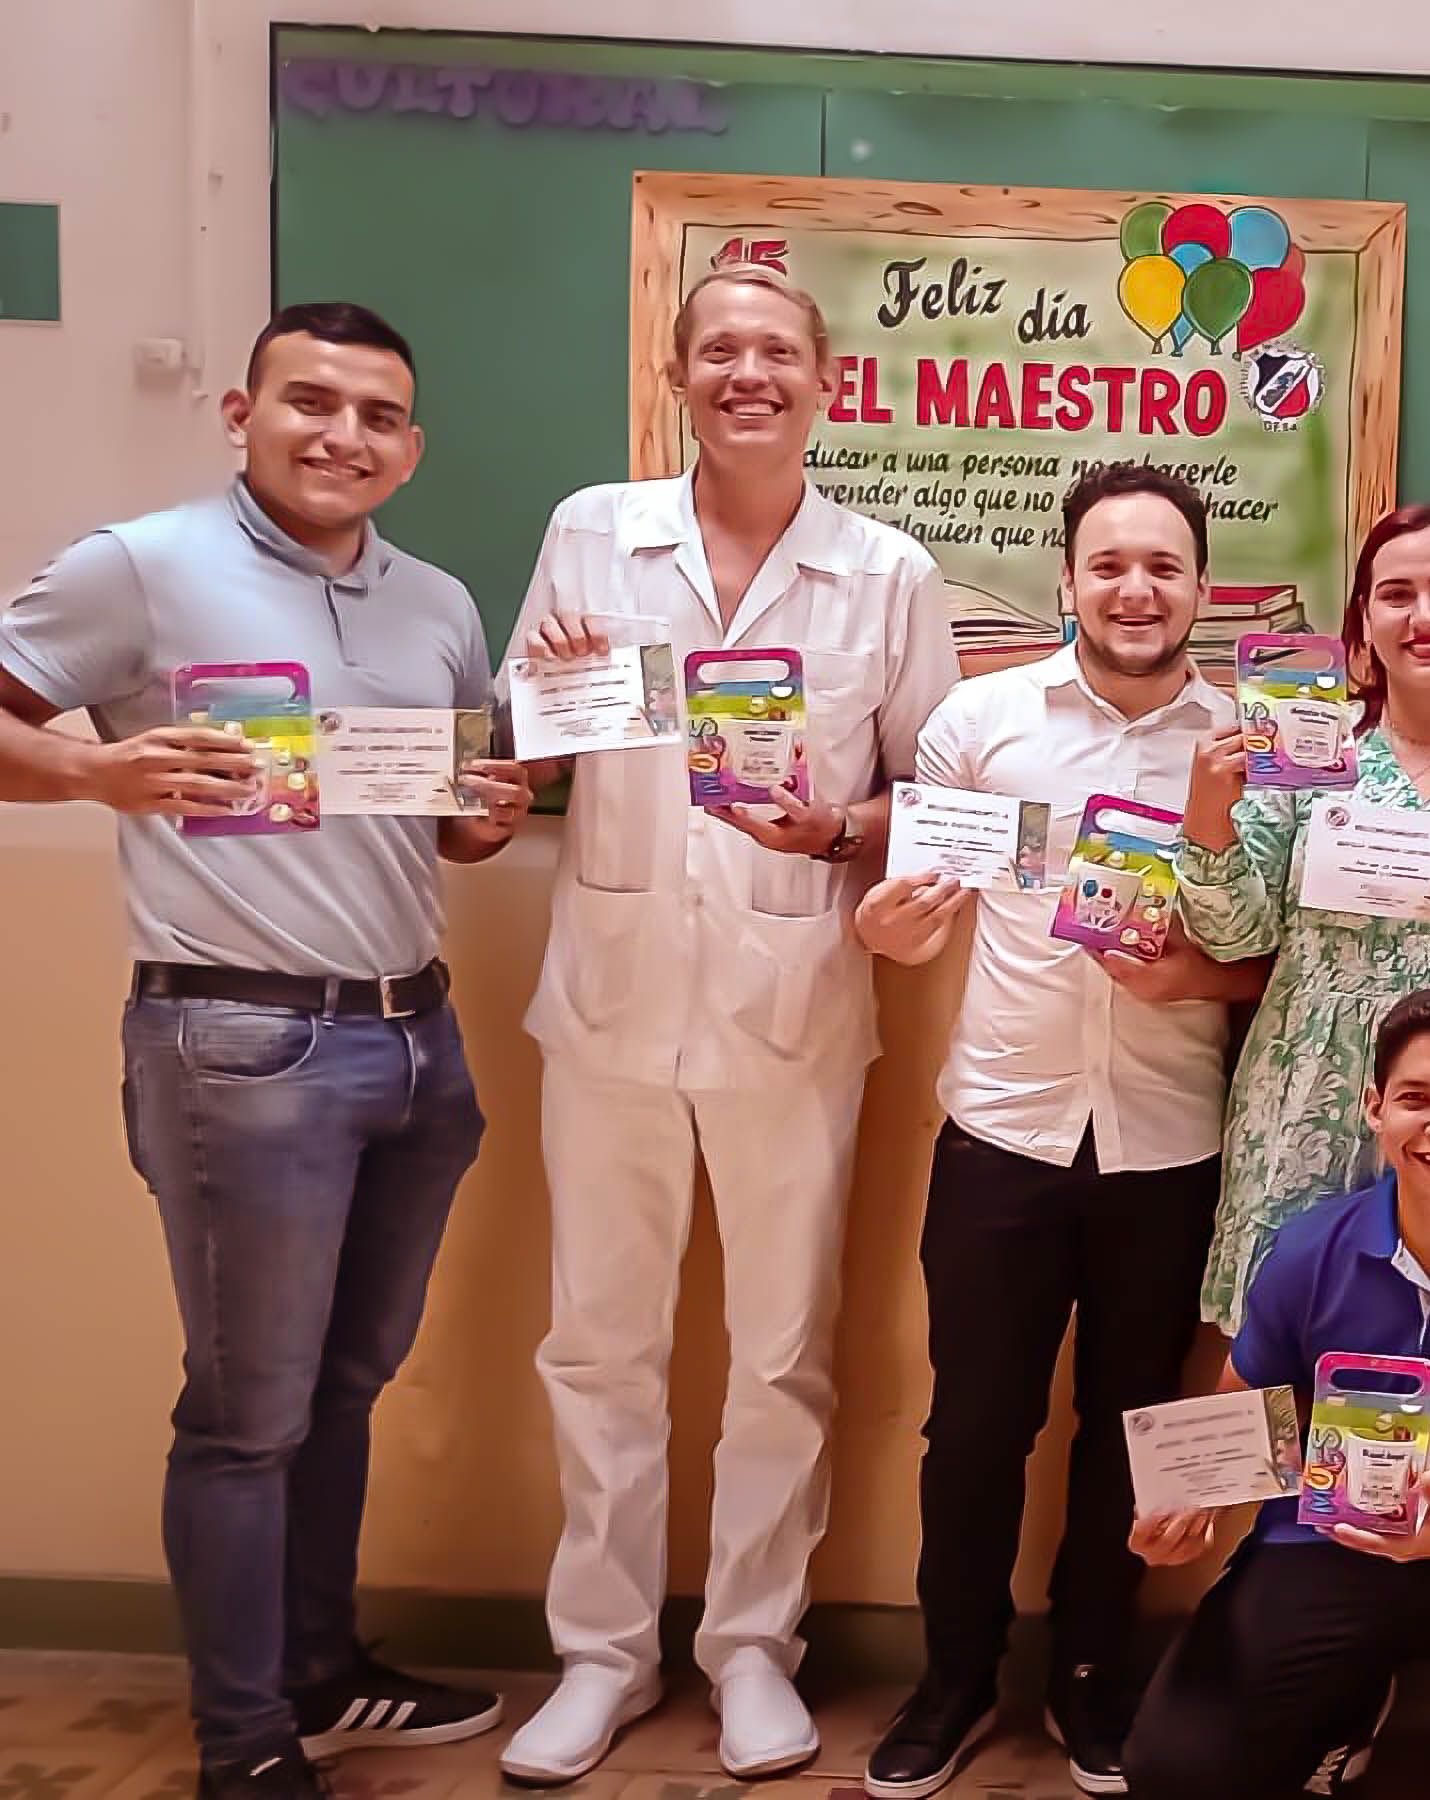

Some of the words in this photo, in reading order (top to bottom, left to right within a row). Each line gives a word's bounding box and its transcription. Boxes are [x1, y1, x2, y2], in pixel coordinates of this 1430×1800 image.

[877, 256, 1008, 328] Feliz
[1018, 287, 1092, 345] día
[827, 355, 894, 423] EL
[916, 358, 1228, 438] MAESTRO
[802, 440, 878, 470] ducar
[882, 449, 898, 473] a
[906, 451, 950, 473] una
[961, 451, 1060, 482] persona
[815, 477, 908, 506] render
[913, 480, 967, 517] algo
[974, 488, 1018, 519] que
[1023, 491, 1056, 513] no
[1205, 491, 1278, 522] hacer
[990, 527, 1037, 554] que
